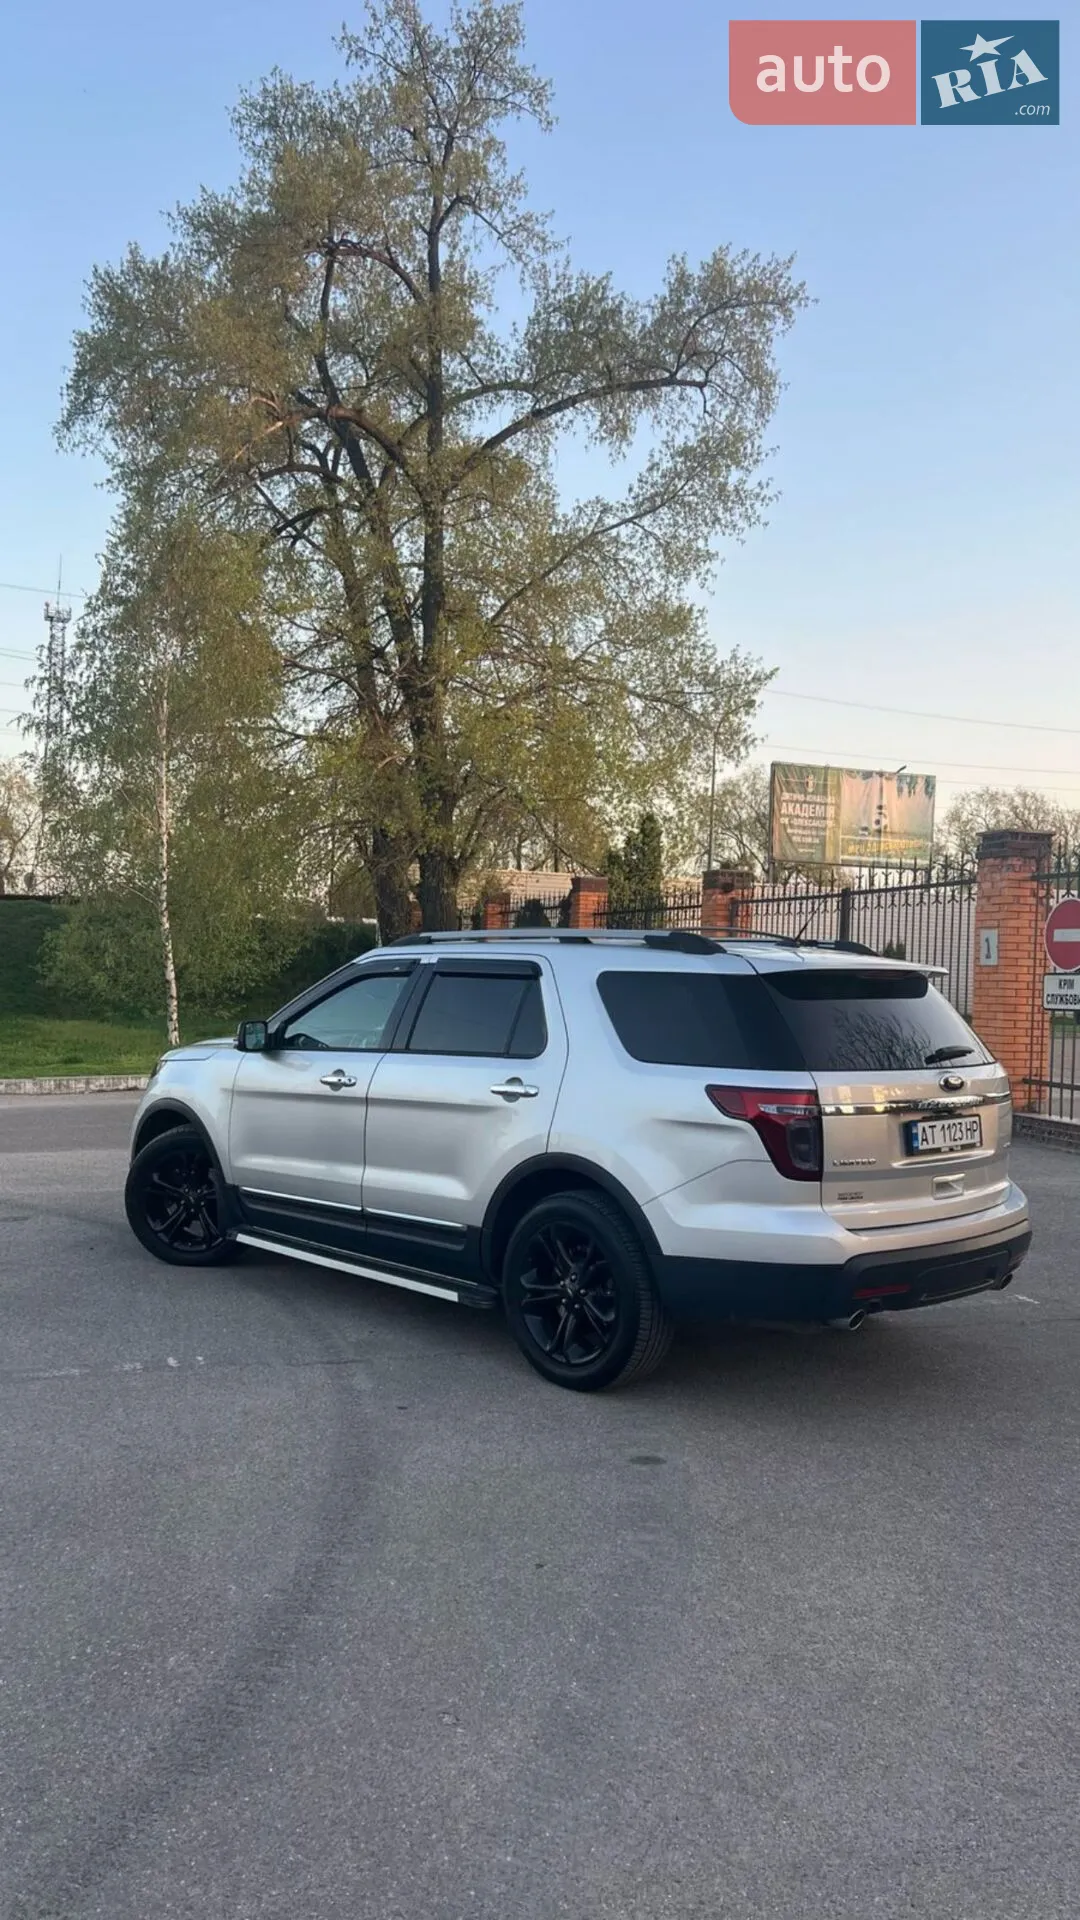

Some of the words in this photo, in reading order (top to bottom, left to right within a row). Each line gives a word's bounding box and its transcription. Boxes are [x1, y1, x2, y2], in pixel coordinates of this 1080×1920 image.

[985, 937, 992, 959] 1
[921, 1125, 937, 1146] AT
[941, 1122, 964, 1144] 1123
[965, 1120, 979, 1140] HP
